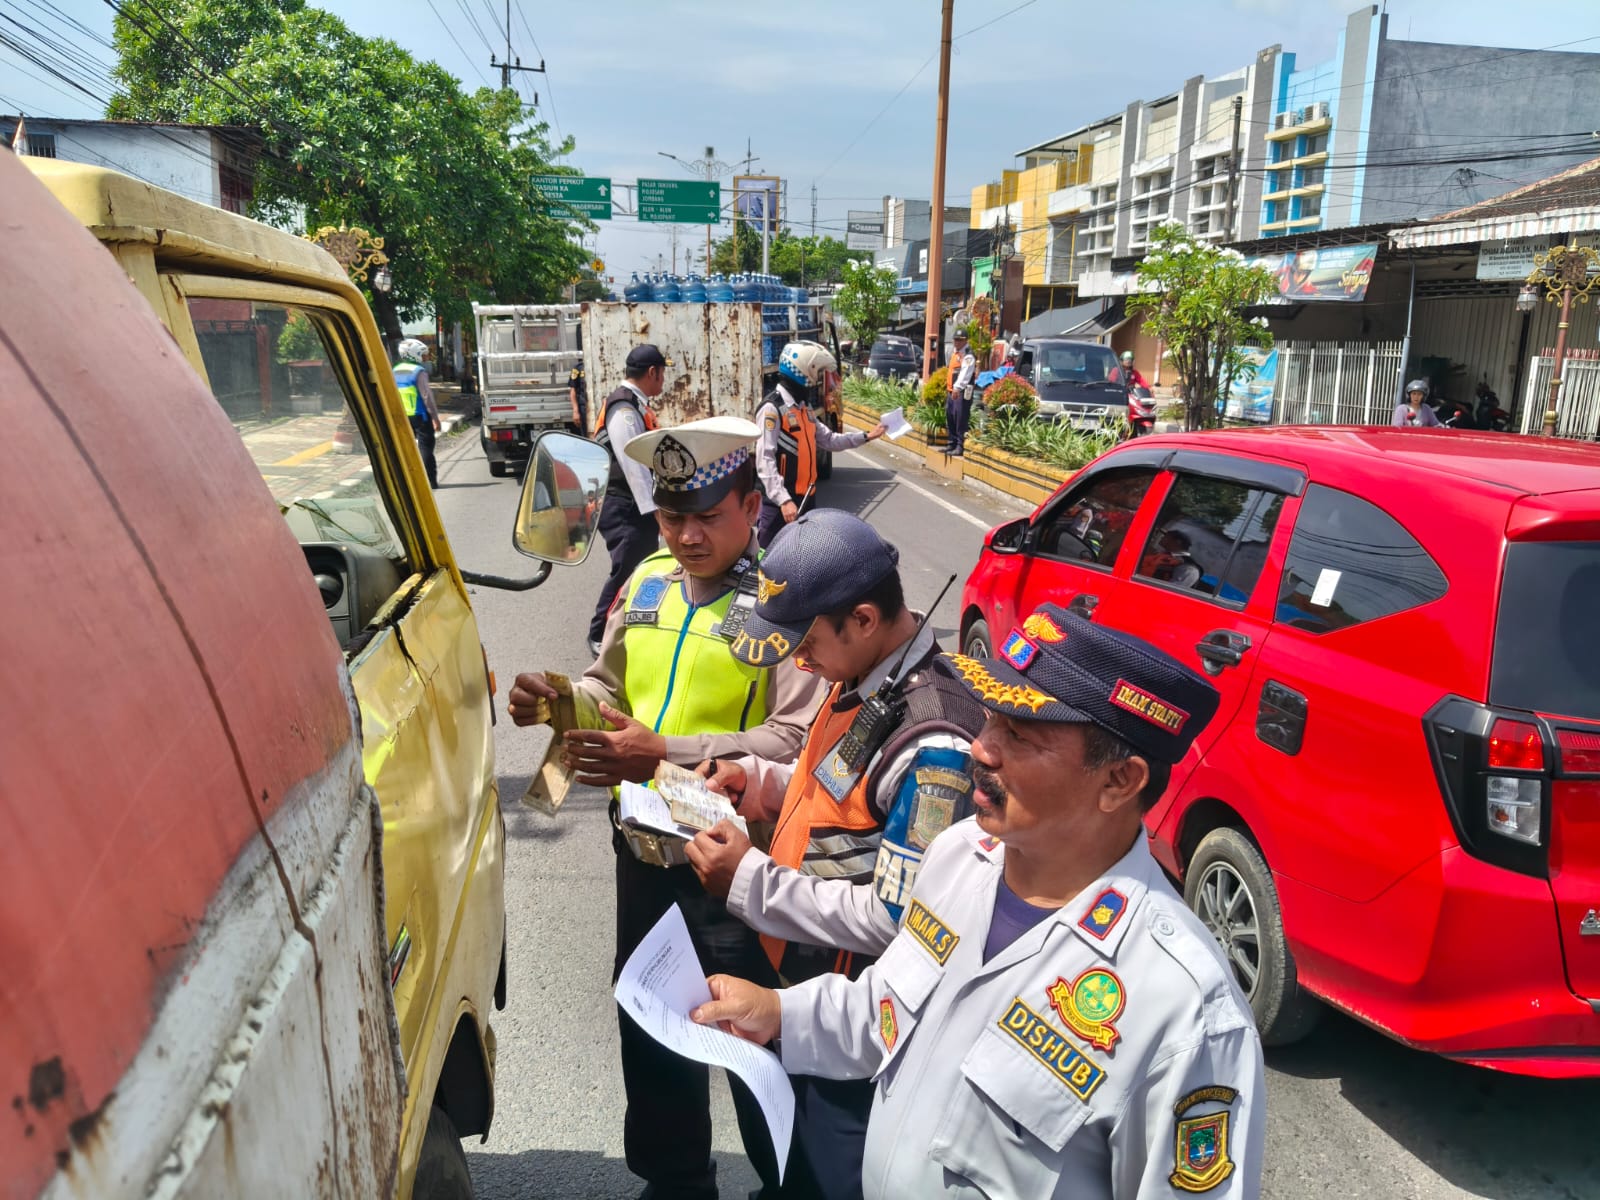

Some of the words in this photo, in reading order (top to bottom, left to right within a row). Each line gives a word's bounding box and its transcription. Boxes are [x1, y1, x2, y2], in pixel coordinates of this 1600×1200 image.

[642, 195, 665, 203] JOMBANG
[1116, 686, 1150, 712] IMAM
[816, 766, 844, 797] DISHUB
[1007, 1006, 1094, 1088] DISHUB
